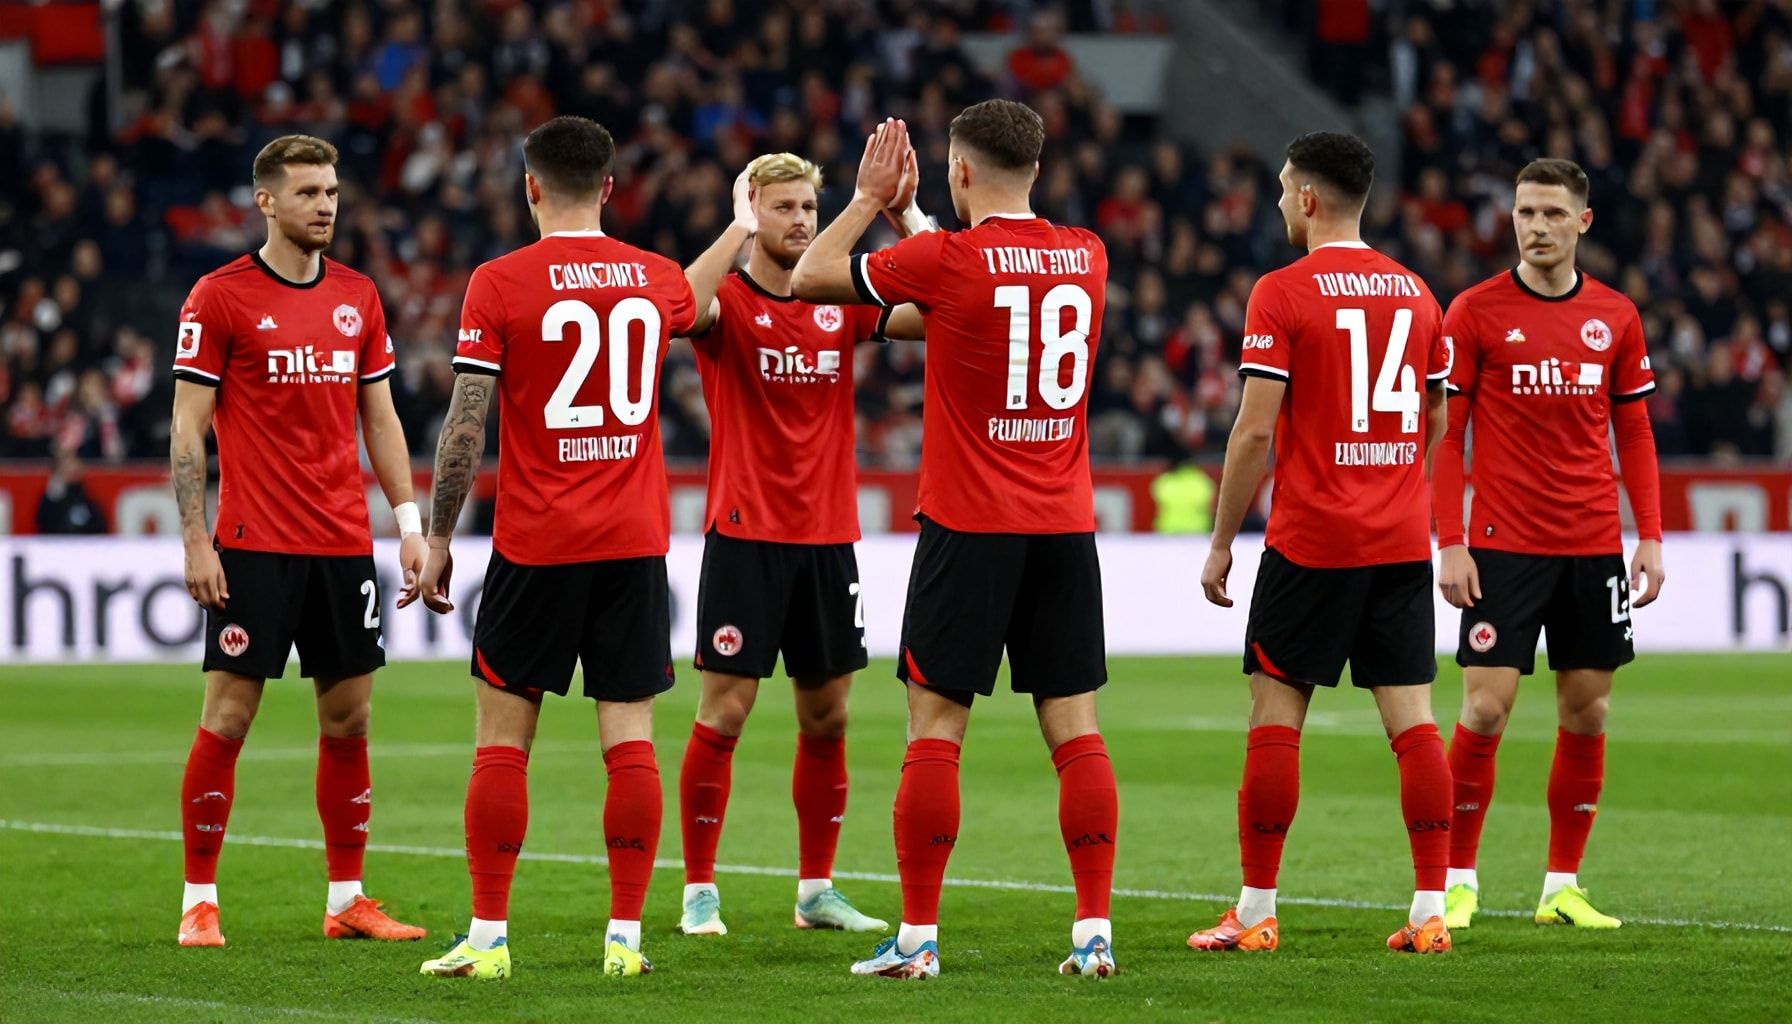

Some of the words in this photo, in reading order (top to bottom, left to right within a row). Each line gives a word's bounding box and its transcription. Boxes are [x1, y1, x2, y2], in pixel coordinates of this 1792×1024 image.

[541, 296, 662, 430] 20
[993, 283, 1093, 411] 18
[1335, 308, 1421, 434] 14
